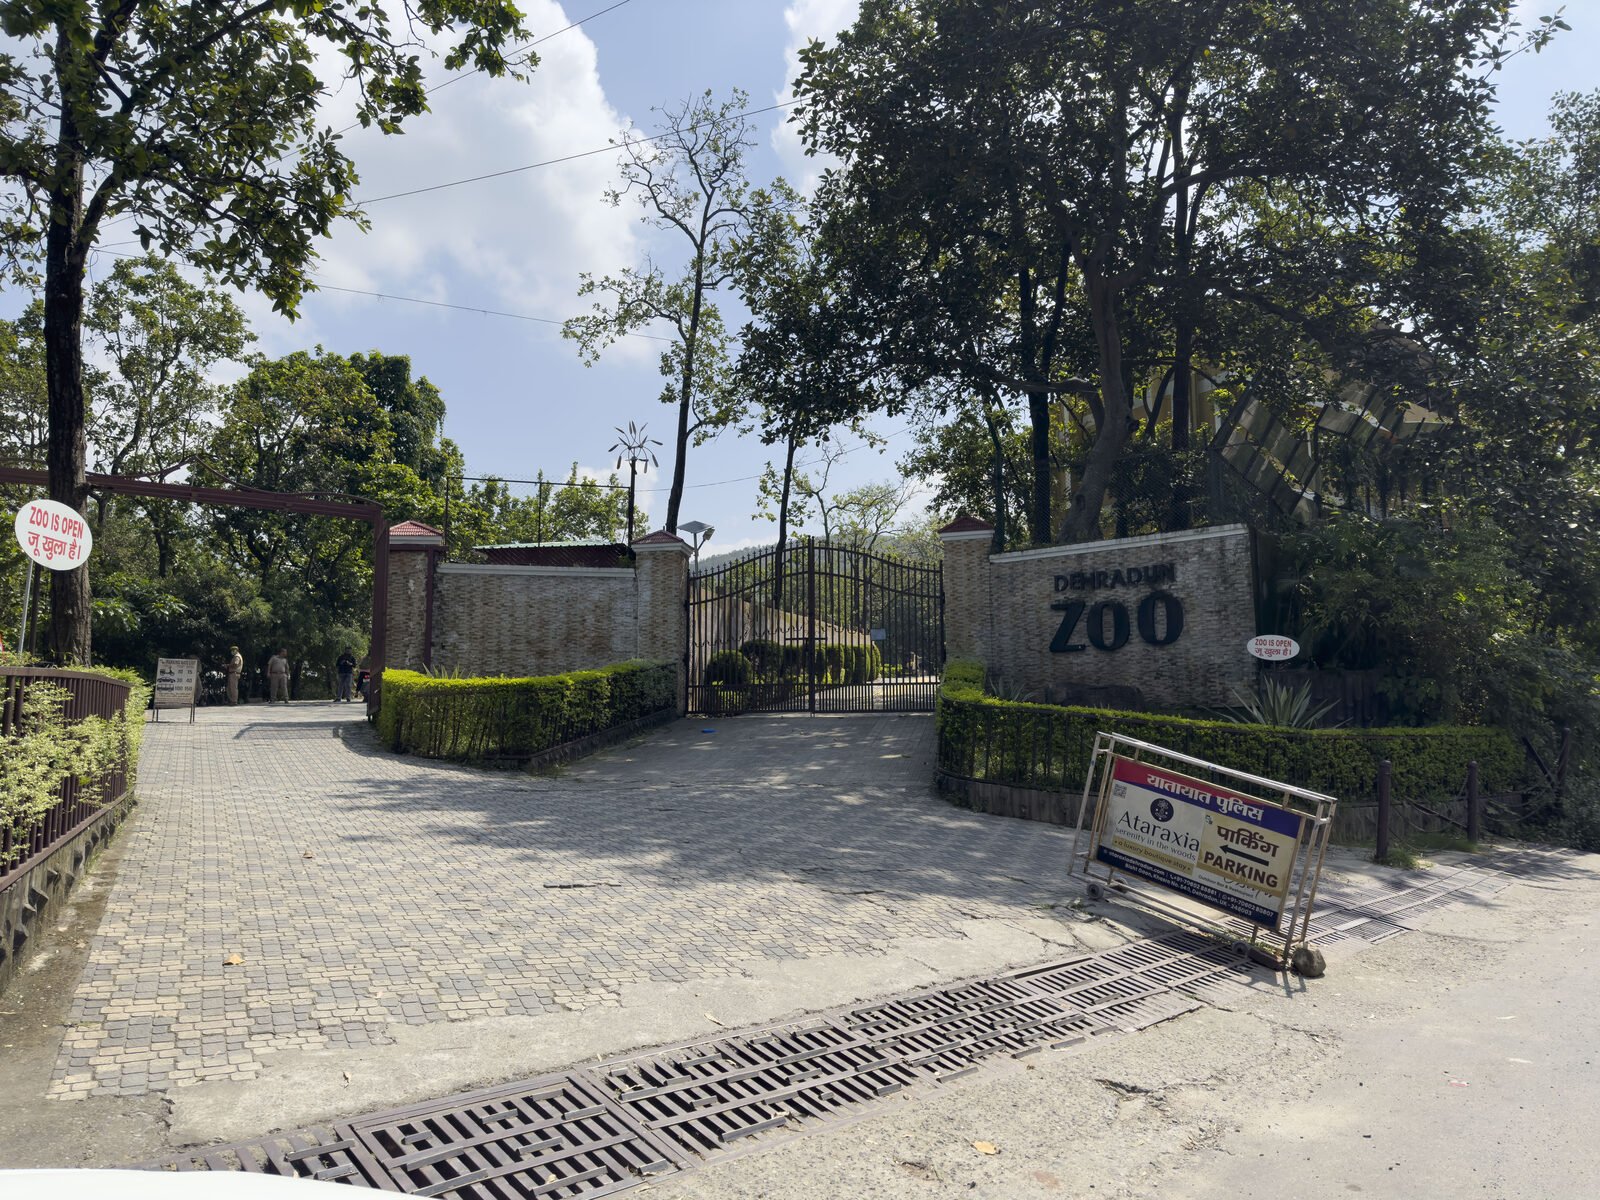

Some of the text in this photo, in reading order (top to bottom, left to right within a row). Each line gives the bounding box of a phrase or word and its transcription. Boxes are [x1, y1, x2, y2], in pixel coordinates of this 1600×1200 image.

[29, 506, 84, 539] ZOO IS OPEN
[28, 531, 40, 557] जू
[42, 536, 67, 560] खुला
[1054, 562, 1176, 592] DEHRADUN
[1049, 590, 1184, 653] ZOO
[1254, 647, 1264, 657] जू
[1264, 648, 1281, 657] खुला
[1275, 640, 1292, 648] OPEN
[1146, 773, 1265, 821] यातायात पुलिस
[1115, 827, 1196, 861] serenity in the woods
[1118, 810, 1200, 852] Ataraxia
[1217, 824, 1280, 858] पार्किंग
[1124, 841, 1143, 853] luxury
[1144, 848, 1172, 864] boutique
[1173, 860, 1186, 870] stay
[1204, 850, 1278, 889] PARKING
